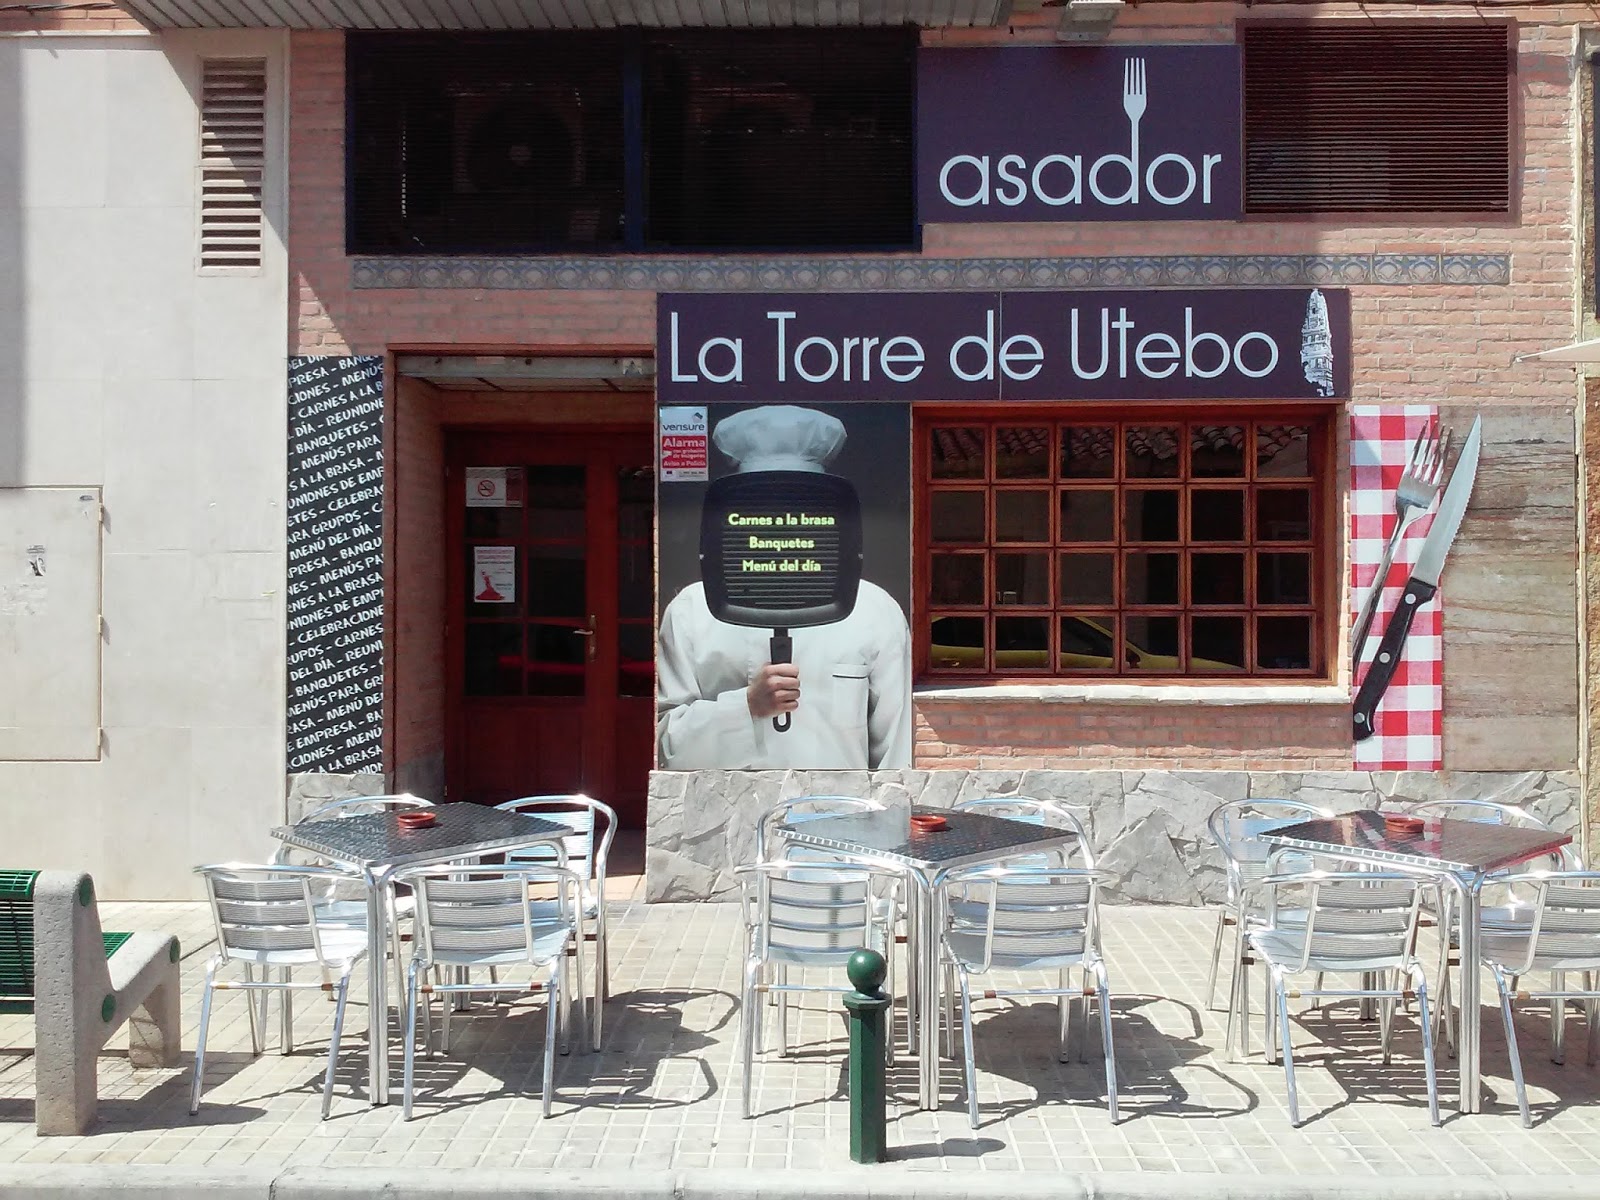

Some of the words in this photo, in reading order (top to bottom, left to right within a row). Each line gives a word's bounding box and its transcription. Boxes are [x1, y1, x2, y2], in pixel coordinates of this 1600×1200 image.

[939, 108, 1222, 206] asador
[671, 312, 743, 383] La
[767, 312, 926, 383] Torre
[949, 309, 1045, 382] de
[1072, 307, 1279, 380] Utebo
[298, 394, 348, 418] CARNES
[350, 391, 359, 401] A
[360, 384, 375, 397] LA
[295, 421, 316, 437] DÍA
[296, 421, 369, 454] BANQUETES
[663, 438, 705, 448] Alarma
[301, 446, 346, 469] MENÚS
[346, 434, 382, 454] PARA
[300, 477, 309, 488] A
[309, 471, 326, 483] LA
[325, 457, 366, 478] BRASA
[288, 483, 339, 509] UNIONES
[339, 476, 357, 490] DE
[312, 510, 362, 535] GRUPOS
[728, 513, 773, 526] Carnes
[775, 516, 783, 526] a
[786, 513, 798, 526] la
[800, 513, 835, 526] brasa
[289, 537, 326, 560] MENÚ
[327, 532, 351, 546] DEL
[352, 522, 374, 538] DÍA
[749, 536, 815, 552] Banquetes
[320, 560, 365, 584] MENÚS
[365, 553, 384, 568] PA
[742, 559, 777, 572] Menú
[779, 559, 799, 572] del
[801, 559, 821, 572] día
[318, 592, 328, 602] A
[328, 586, 344, 598] LA
[344, 572, 384, 592] BRASA
[288, 606, 333, 630] NIONES
[334, 600, 351, 613] DE
[335, 622, 384, 647] CARNES
[290, 667, 313, 681] DEL
[314, 656, 335, 673] DÍA
[295, 662, 369, 697] BANQUETES
[328, 683, 363, 702] PARA
[326, 696, 363, 720] MENÚ
[296, 720, 357, 749] EMPRESA
[328, 759, 345, 771] LA
[344, 745, 384, 765] BRASA
